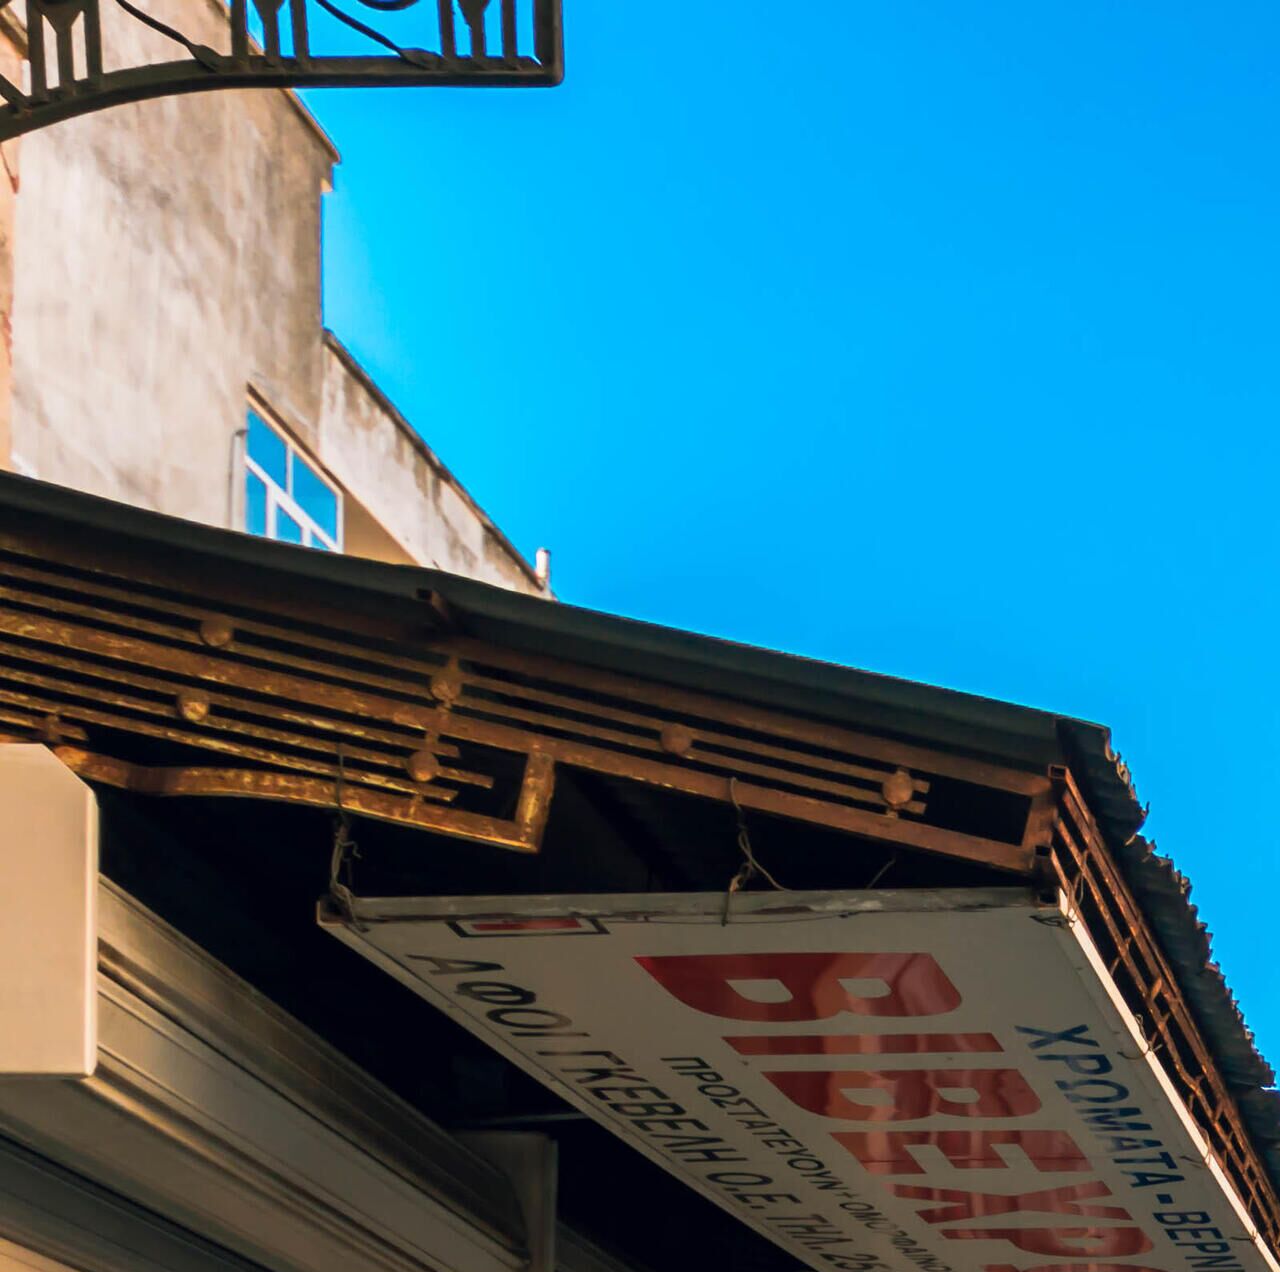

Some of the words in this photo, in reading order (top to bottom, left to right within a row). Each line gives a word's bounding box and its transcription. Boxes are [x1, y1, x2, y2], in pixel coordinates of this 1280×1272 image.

[405, 954, 590, 1037] ΑΦΟΙ
[536, 1050, 748, 1162] ΓΚΕΒΕΛΗ
[661, 1056, 845, 1190] ΠΡΟΣΤΑΤΕΥΟΥΝ
[1014, 1024, 1184, 1188] ΧΡΩΜΑΤΑ
